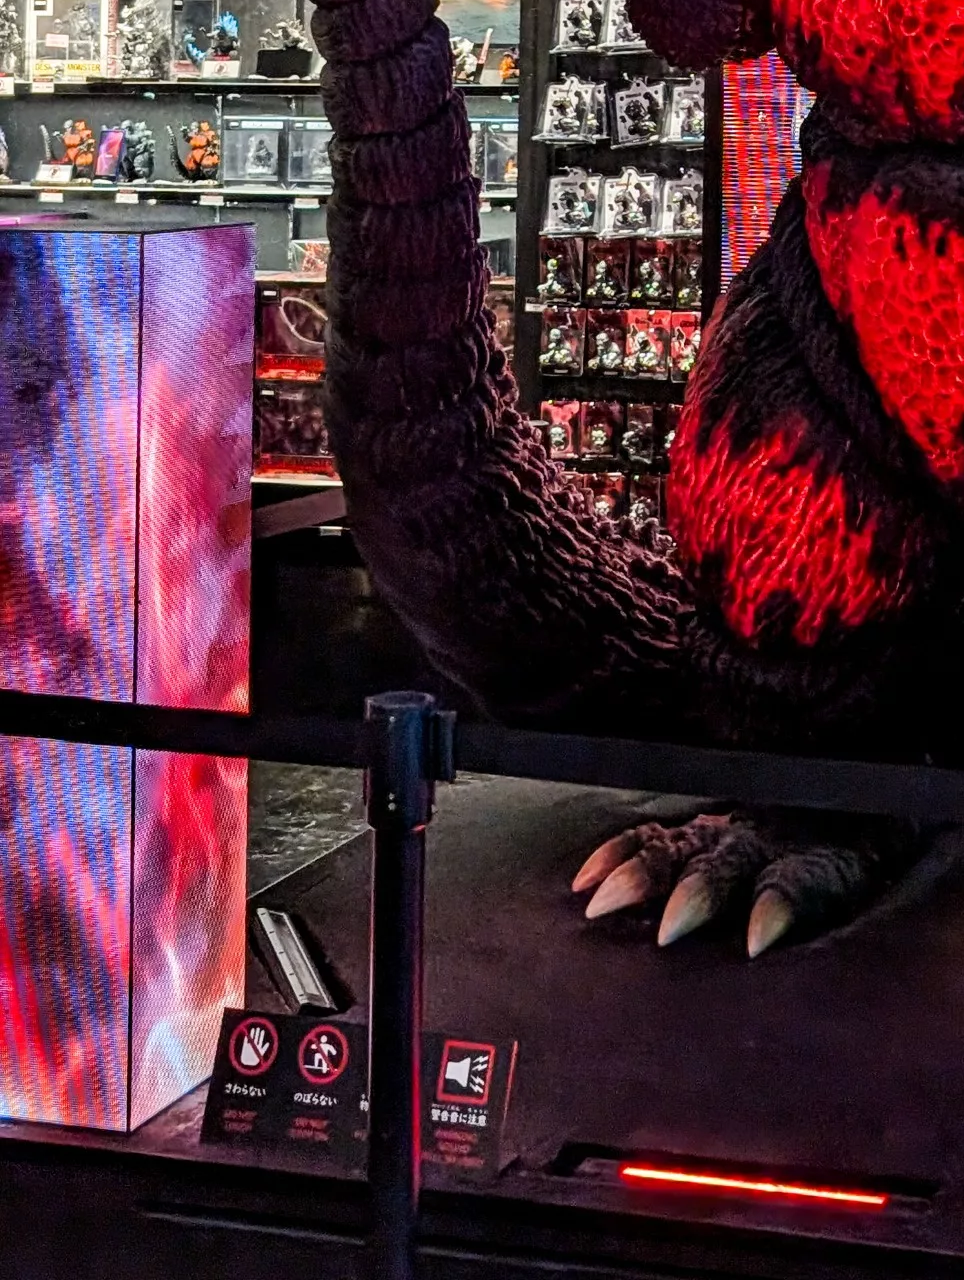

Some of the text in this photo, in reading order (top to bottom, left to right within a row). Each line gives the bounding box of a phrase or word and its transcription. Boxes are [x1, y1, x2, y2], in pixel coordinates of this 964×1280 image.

[224, 1082, 267, 1097] さわらない
[293, 1092, 338, 1107] のぼらない
